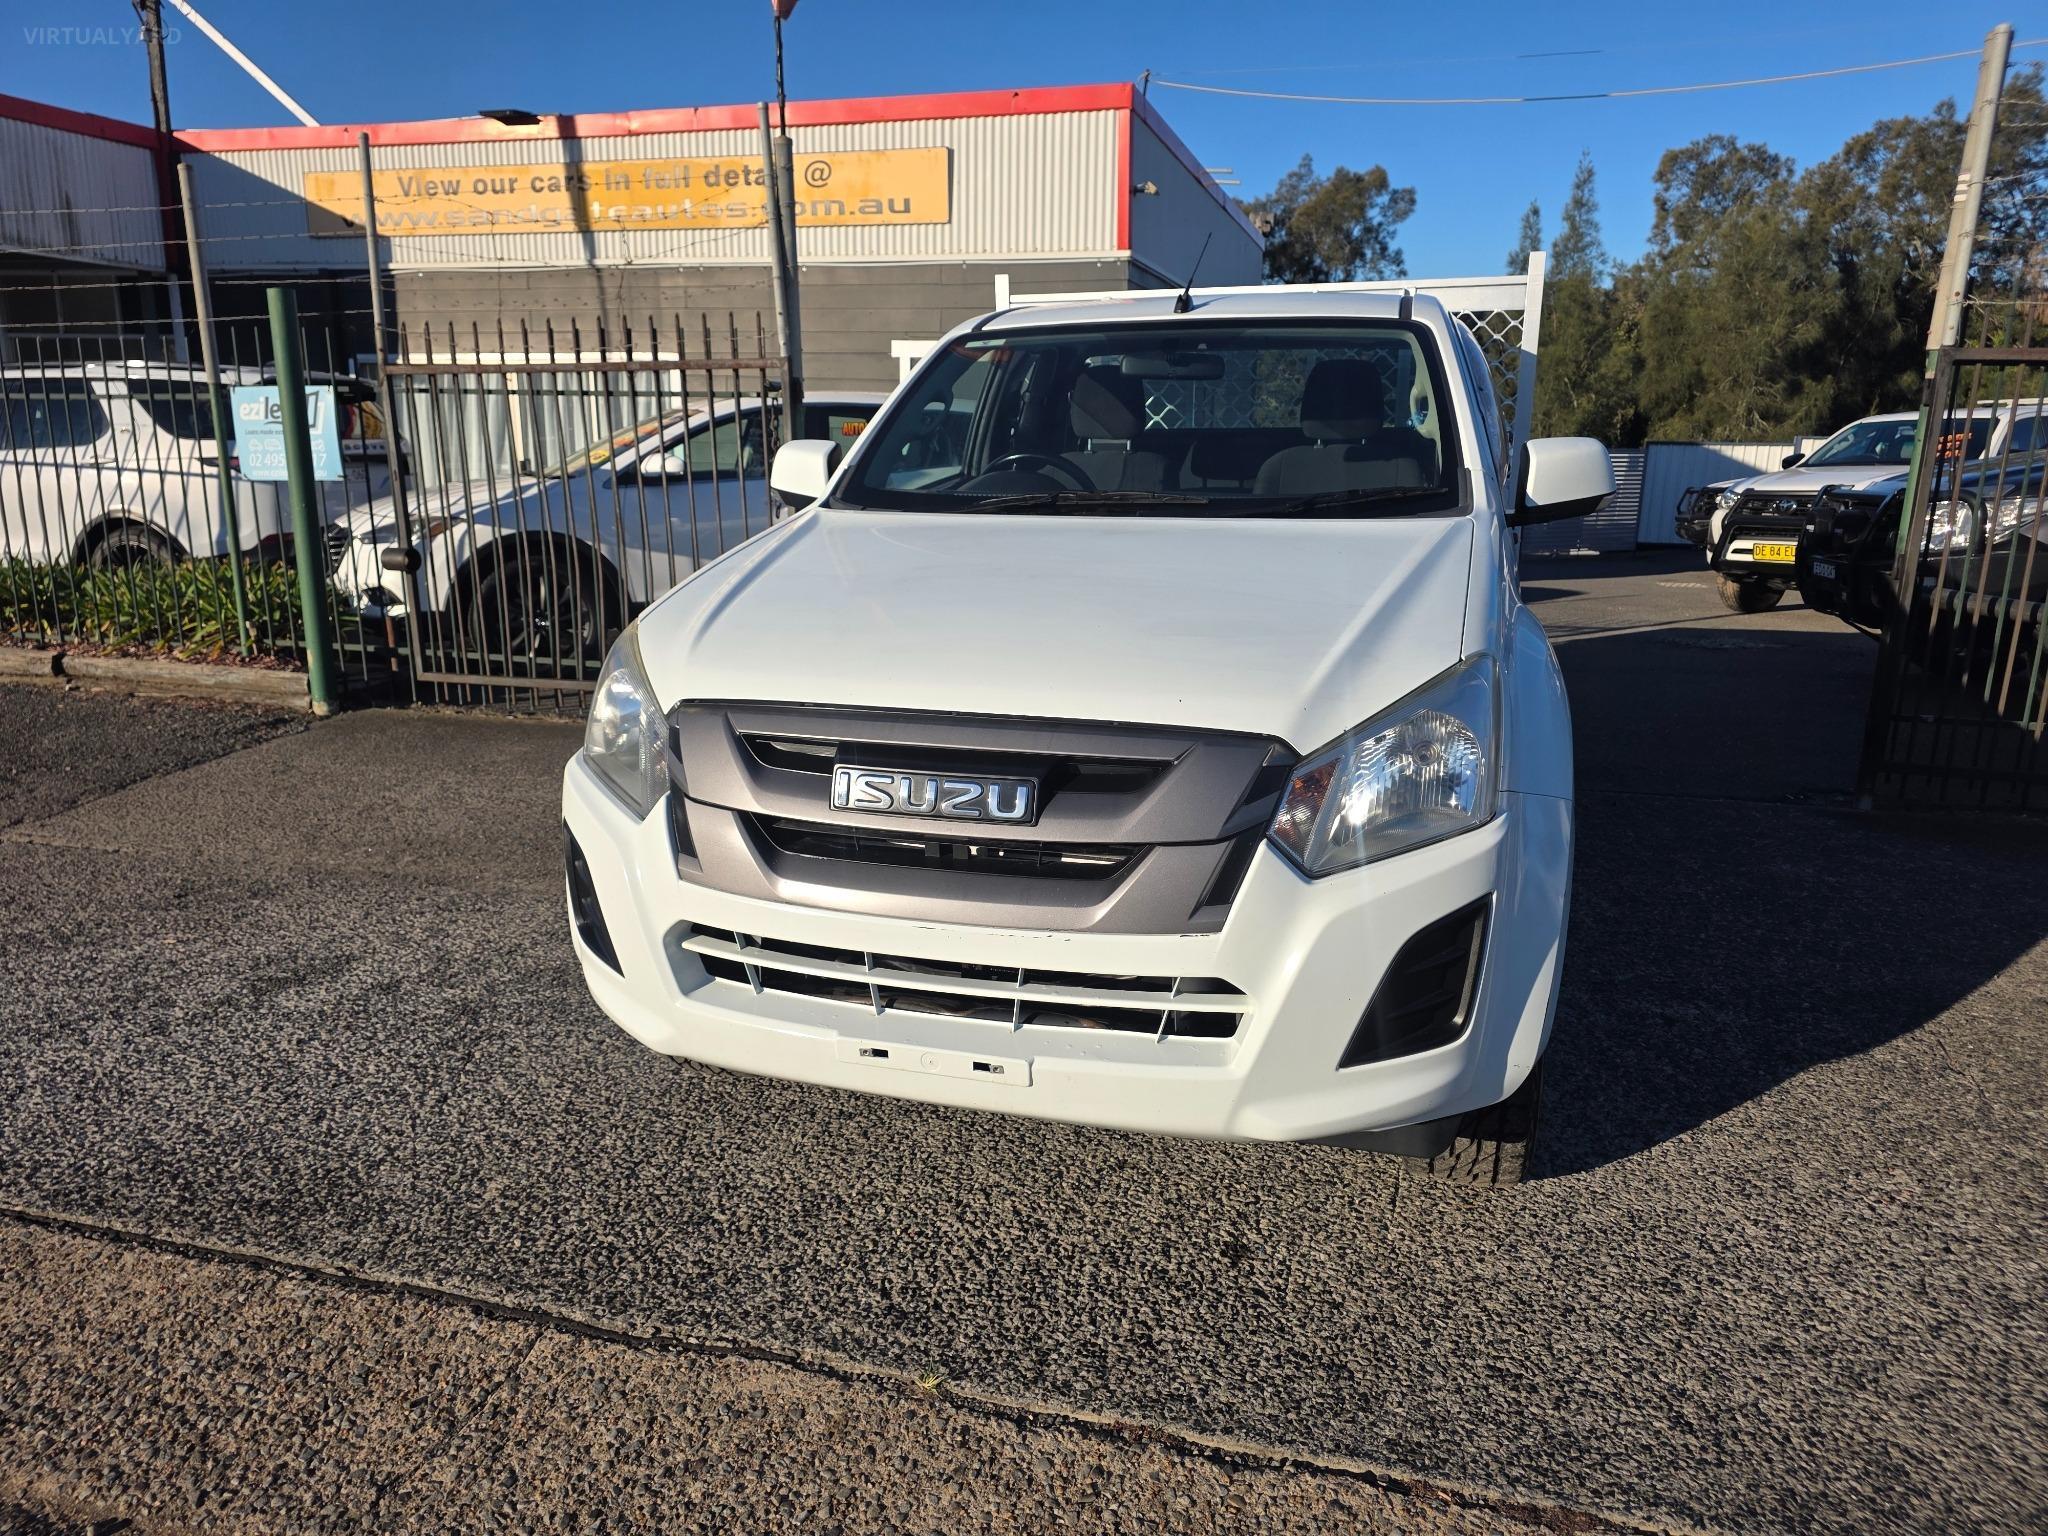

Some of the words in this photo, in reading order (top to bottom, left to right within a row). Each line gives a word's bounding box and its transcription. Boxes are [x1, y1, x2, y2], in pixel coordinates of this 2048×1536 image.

[397, 175, 461, 197] View
[473, 176, 518, 195] our
[530, 174, 592, 194] cars
[605, 167, 631, 191] in
[643, 164, 690, 190] full
[704, 164, 767, 187] deta
[804, 160, 832, 188] @
[240, 396, 282, 421] ezile
[1755, 546, 1767, 556] DE
[835, 771, 1030, 819] ISUZU
